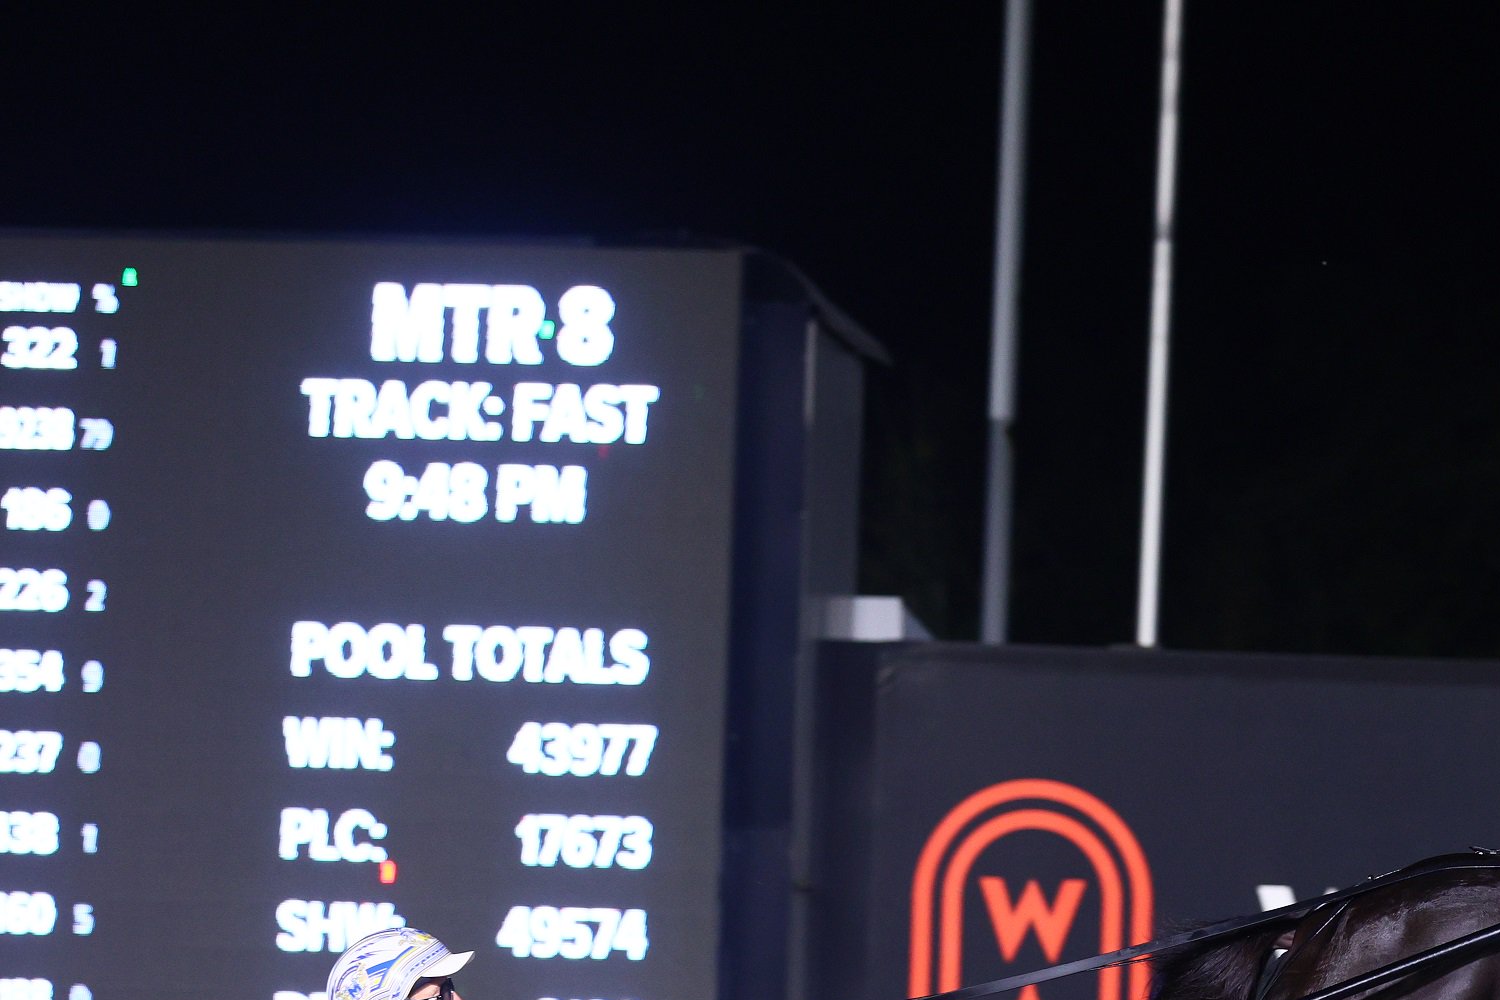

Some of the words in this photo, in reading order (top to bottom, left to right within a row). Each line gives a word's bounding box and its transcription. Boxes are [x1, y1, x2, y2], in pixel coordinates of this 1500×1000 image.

[1, 326, 77, 369] 322
[101, 340, 116, 367] 1
[370, 282, 540, 364] MTR
[556, 285, 615, 366] 8
[300, 378, 505, 441] TRACK:
[512, 382, 660, 444] FAST
[363, 460, 488, 522] 9:48
[495, 464, 587, 523] PM
[86, 580, 106, 611] 2
[290, 621, 438, 680] POOL
[443, 625, 650, 685] TOTALS
[282, 716, 395, 771] WIN:
[507, 722, 658, 776] 43977
[82, 824, 98, 852] 1
[279, 807, 388, 862] PLC:
[515, 814, 653, 869] 17673
[73, 904, 95, 935] 5
[496, 905, 648, 960] 49574
[978, 876, 1088, 964] W
